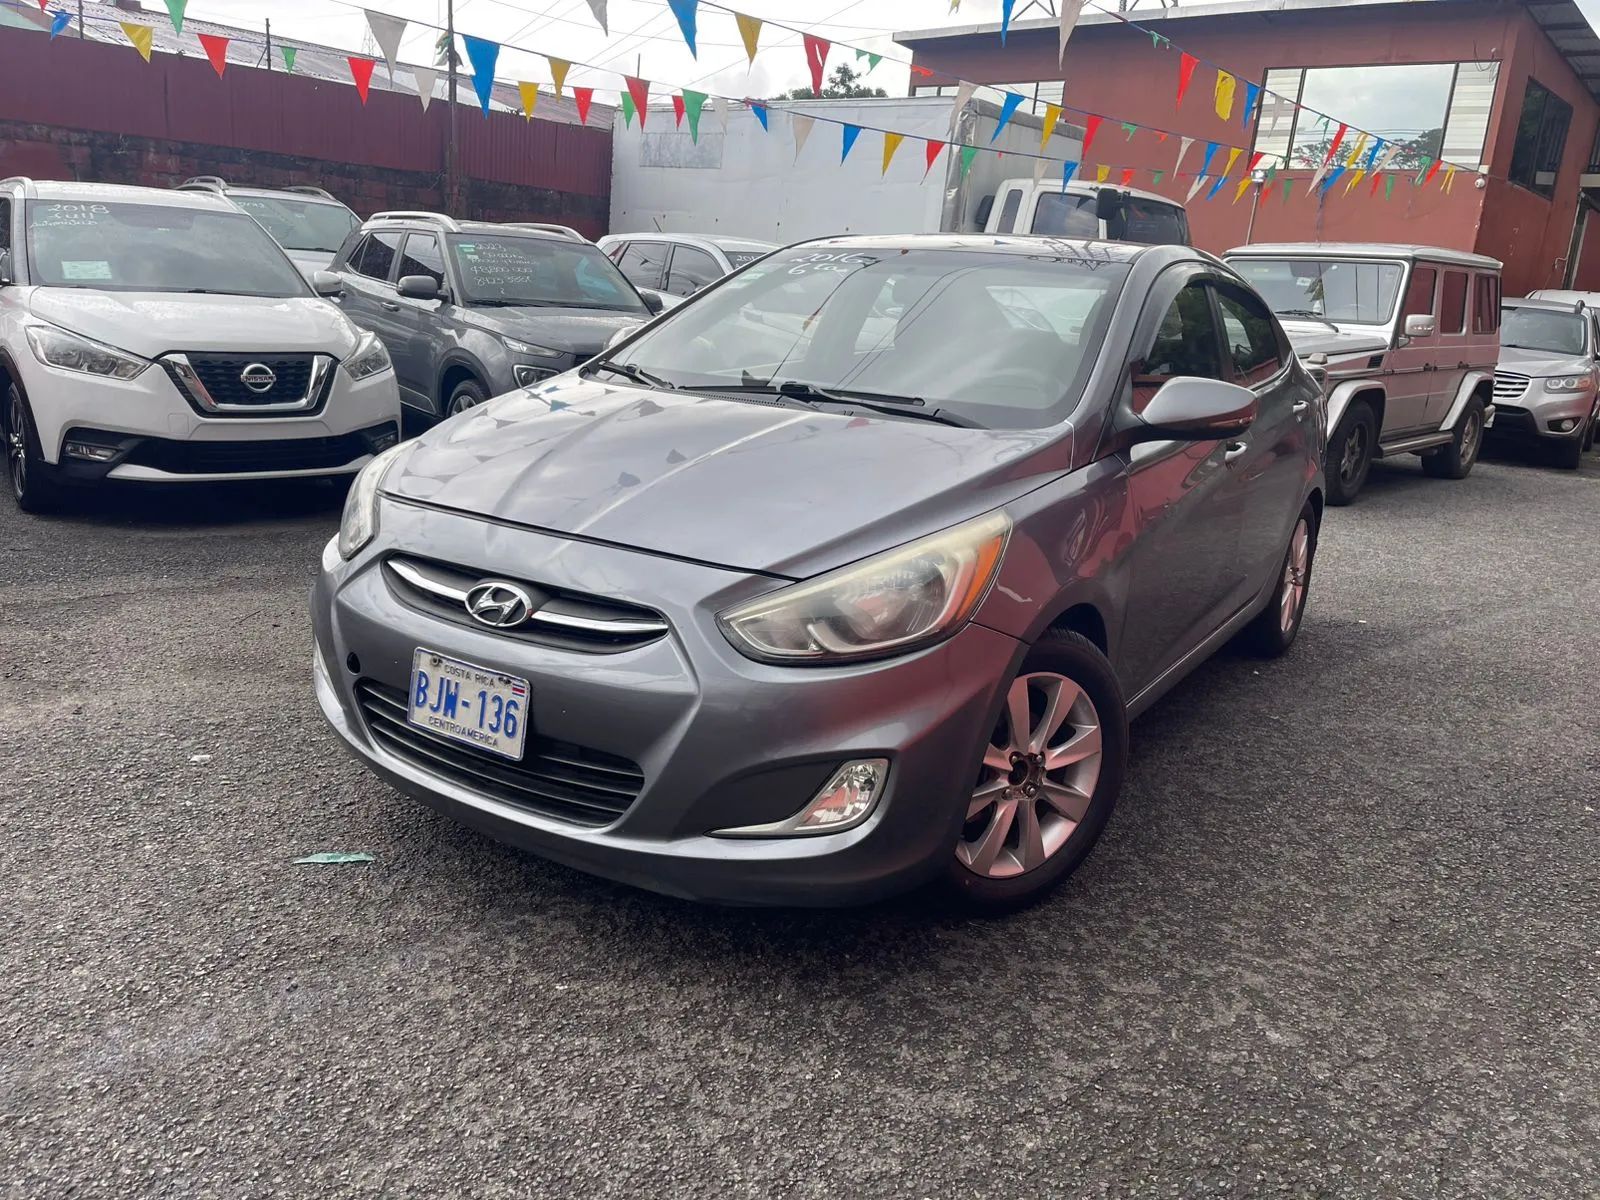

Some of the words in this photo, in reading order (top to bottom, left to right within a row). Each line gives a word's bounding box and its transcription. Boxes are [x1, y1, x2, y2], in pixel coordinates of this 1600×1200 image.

[48, 204, 110, 214] 2018
[790, 252, 864, 263] 2016
[444, 664, 472, 681] COSTA
[475, 673, 496, 688] RICA
[415, 669, 520, 739] BJW-136
[428, 715, 499, 748] CENTROAMERICA
